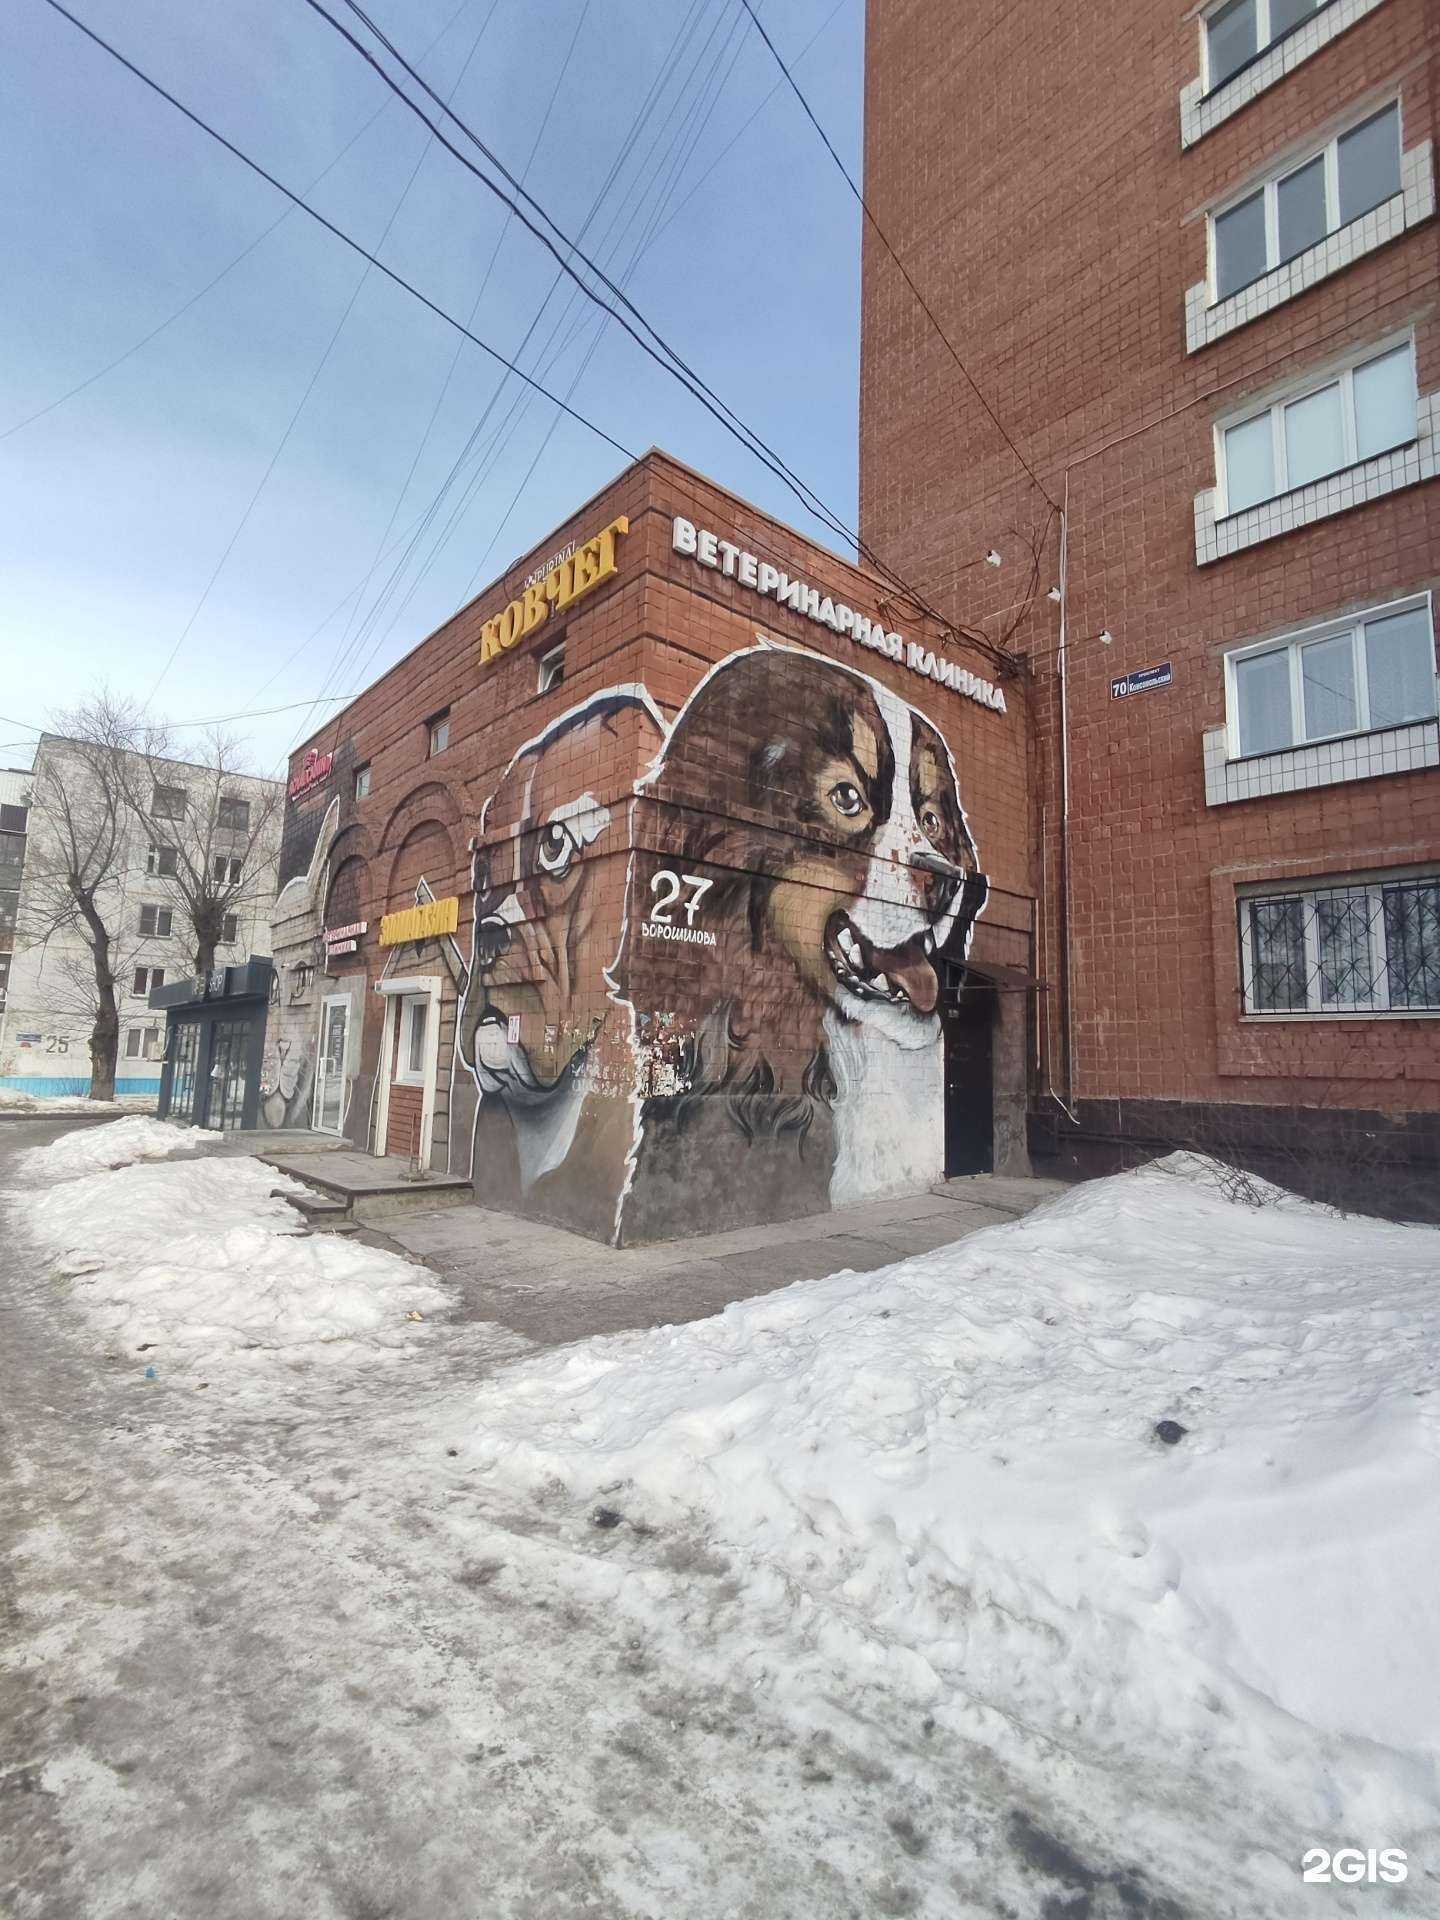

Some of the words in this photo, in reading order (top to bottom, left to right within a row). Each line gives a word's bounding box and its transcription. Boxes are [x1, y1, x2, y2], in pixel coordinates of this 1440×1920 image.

[478, 515, 629, 666] КОВЧЕГ
[672, 516, 903, 662] ВЕТЕРИНАРНАЯ
[906, 642, 1007, 714] КЛИНИКА
[1112, 681, 1127, 697] 70
[1129, 672, 1171, 693] Кососкй
[650, 870, 714, 926] 27
[641, 922, 717, 946] ВОРОШИЛОВА
[46, 1035, 70, 1054] 25
